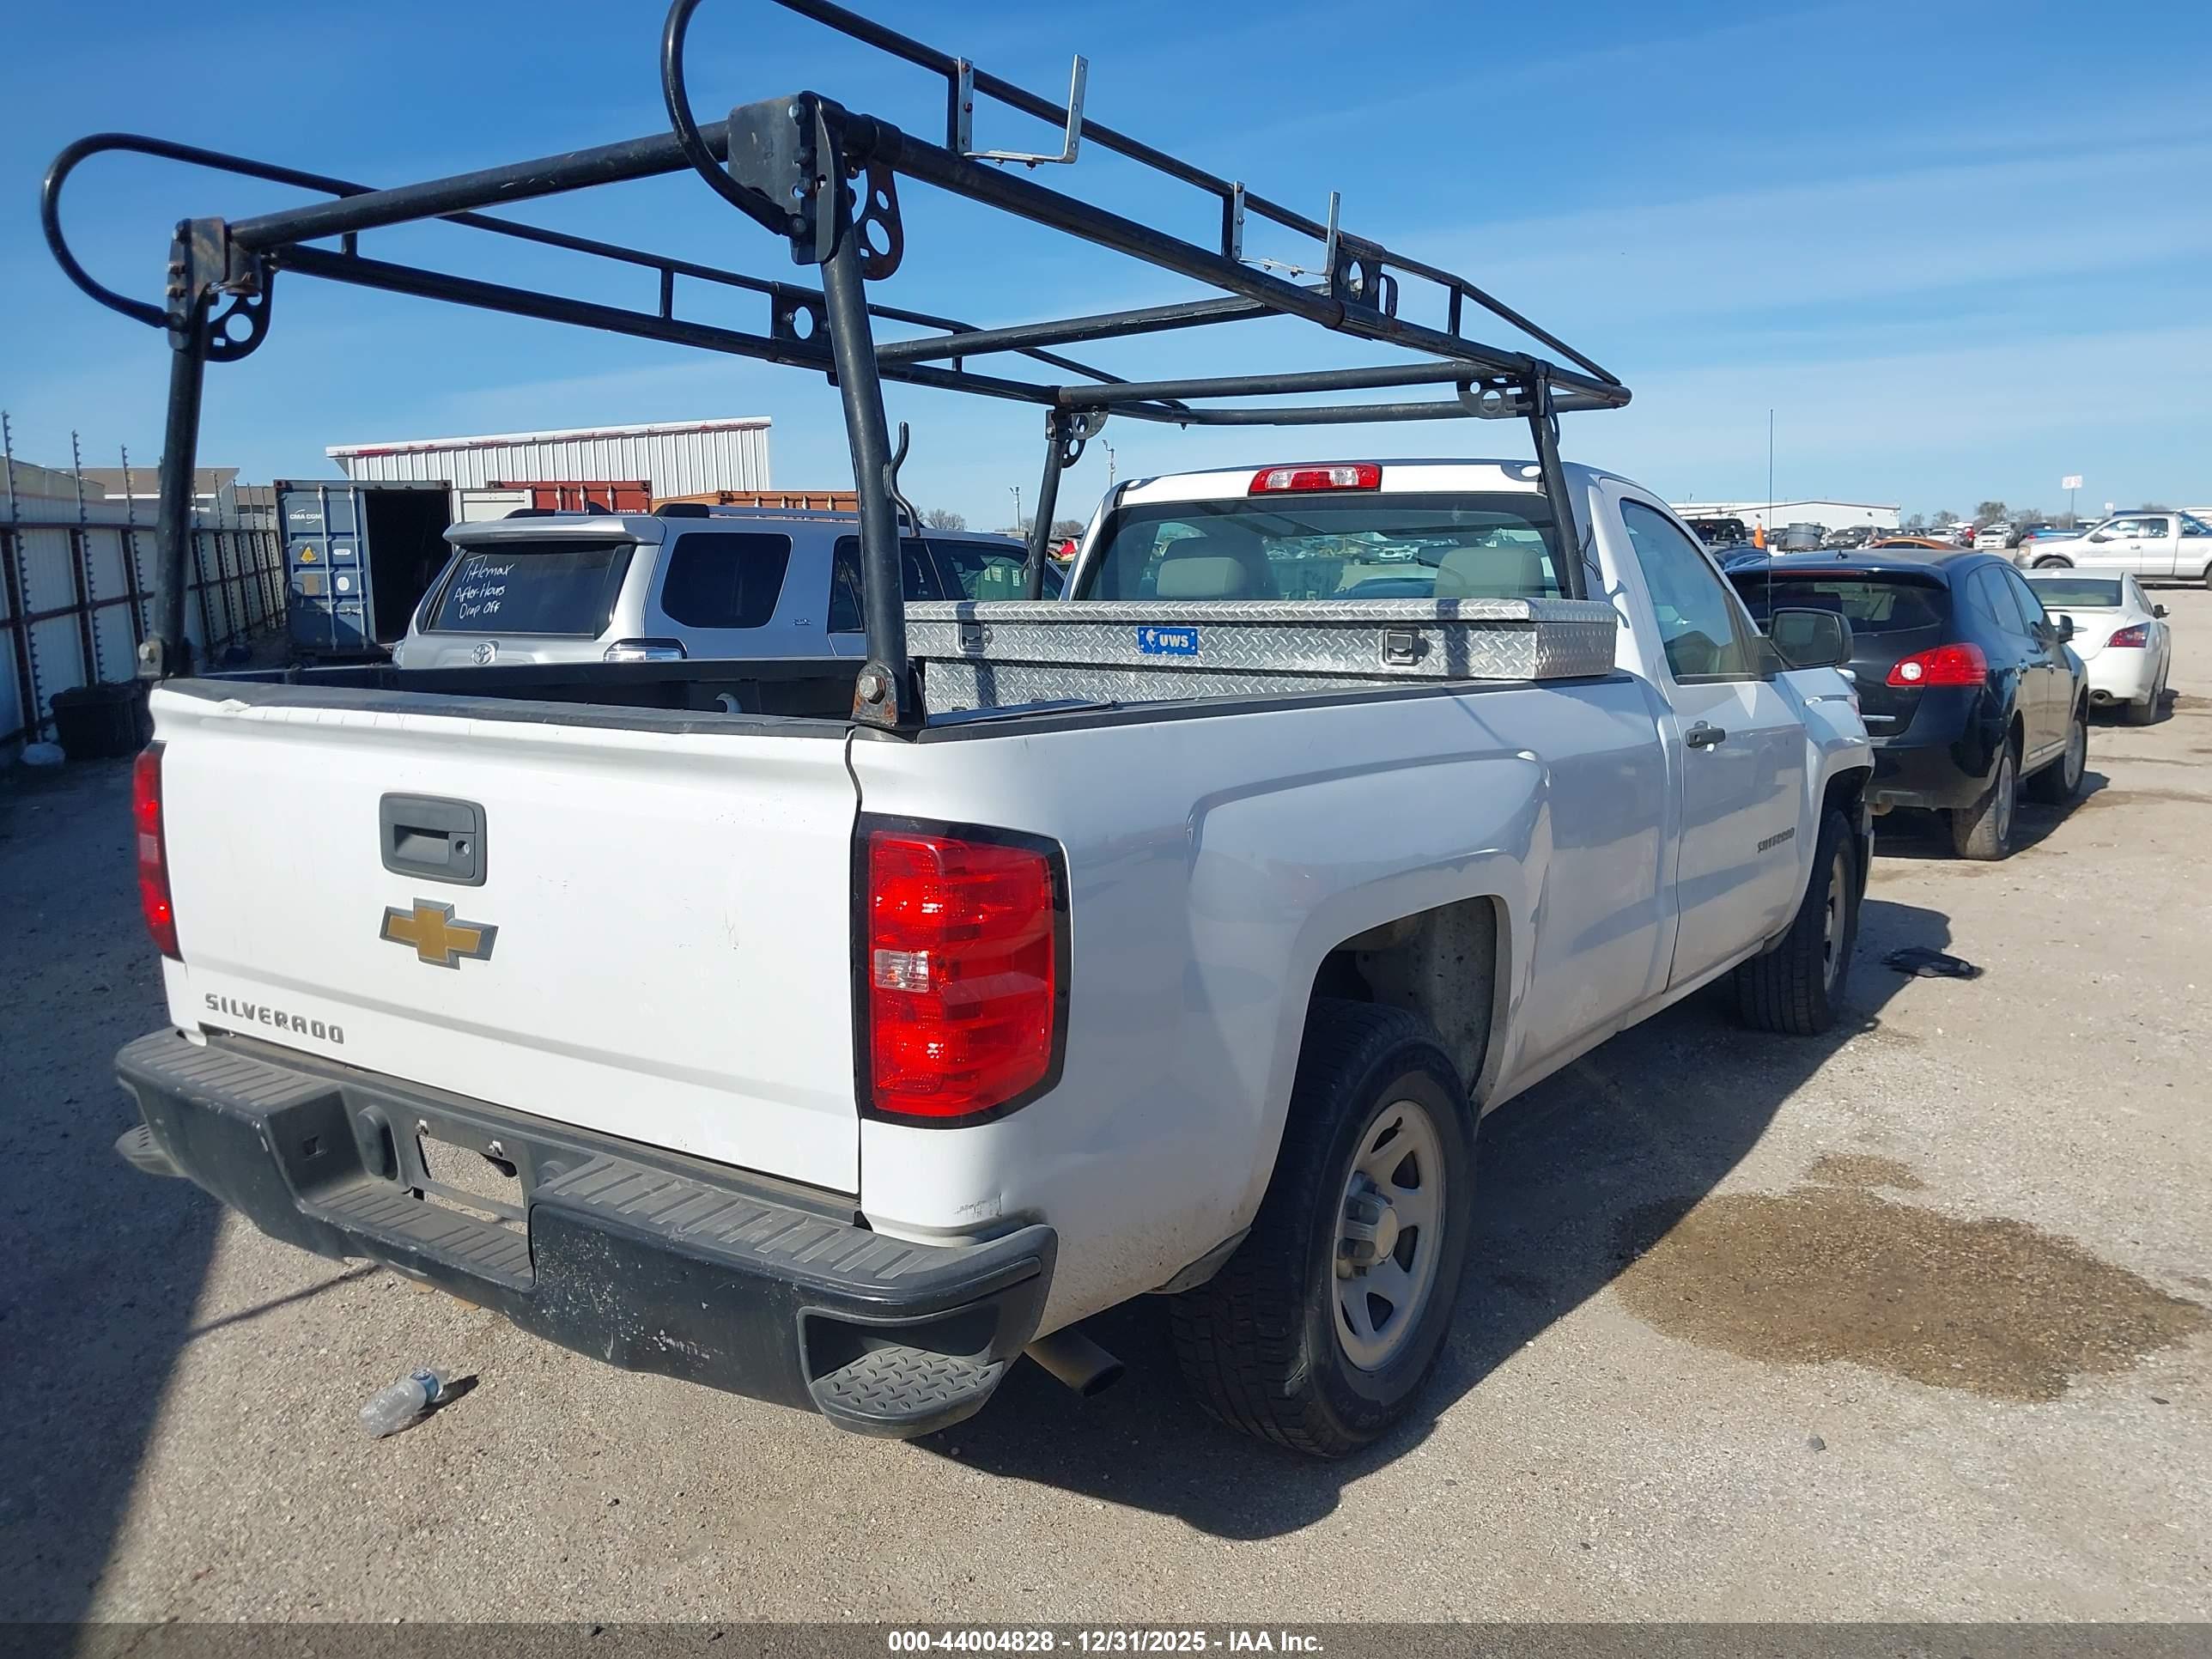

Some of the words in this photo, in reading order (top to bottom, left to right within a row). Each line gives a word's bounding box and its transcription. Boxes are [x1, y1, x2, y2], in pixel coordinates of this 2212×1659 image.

[459, 603, 480, 619] Drop
[1159, 634, 1188, 647] UWS
[205, 993, 343, 1044] SILVERADO
